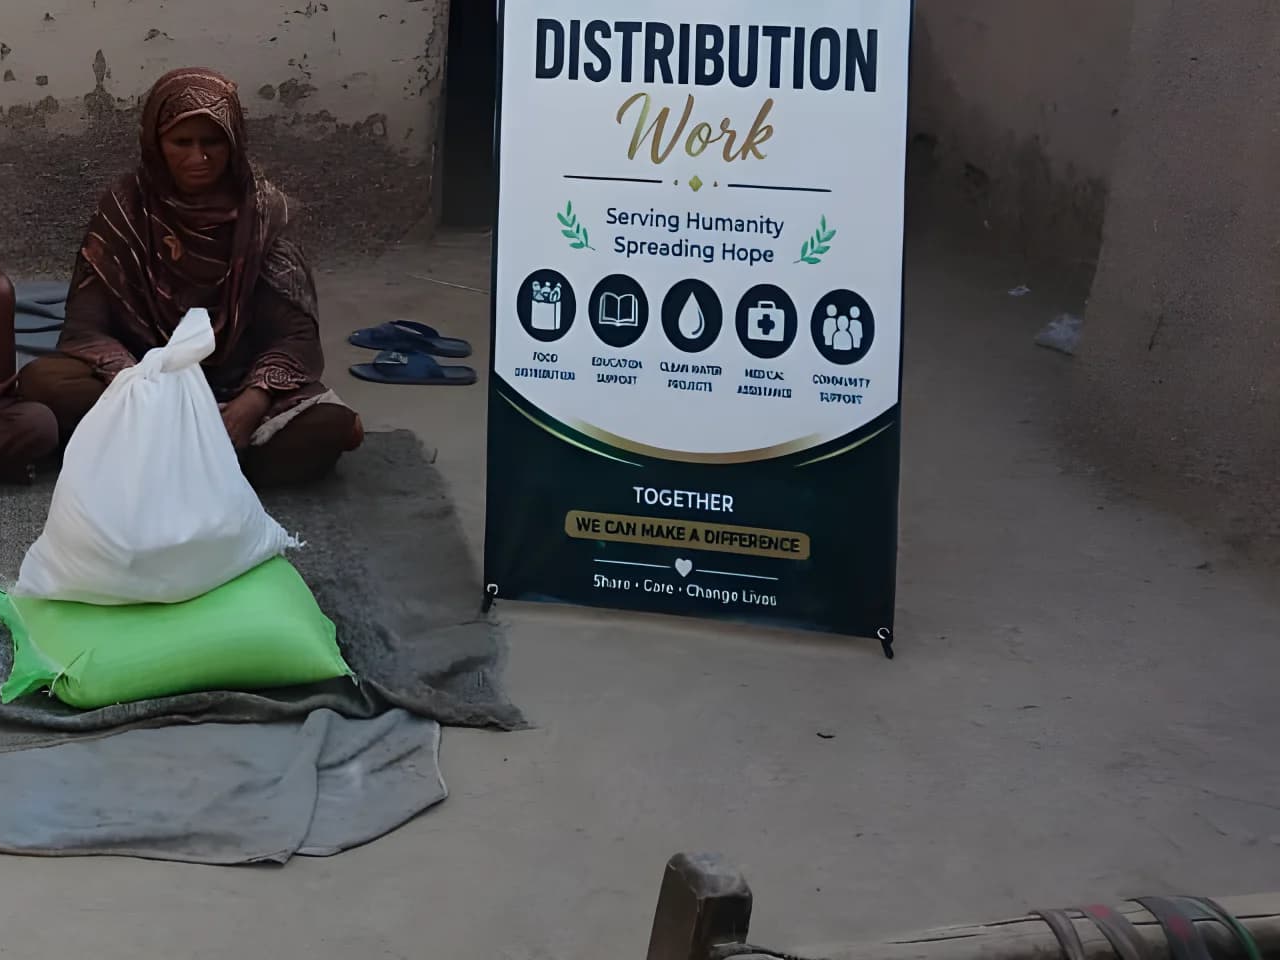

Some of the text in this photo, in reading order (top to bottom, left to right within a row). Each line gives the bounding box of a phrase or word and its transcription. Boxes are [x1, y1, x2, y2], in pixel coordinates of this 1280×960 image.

[535, 18, 879, 93] DISTRIBUTION
[616, 92, 775, 165] Work
[606, 207, 784, 239] Serving Humanity
[614, 236, 774, 266] Spreading Hope
[633, 486, 734, 513] TOGETHER
[576, 516, 801, 553] WE CAN MAKE A DIFFERENCE
